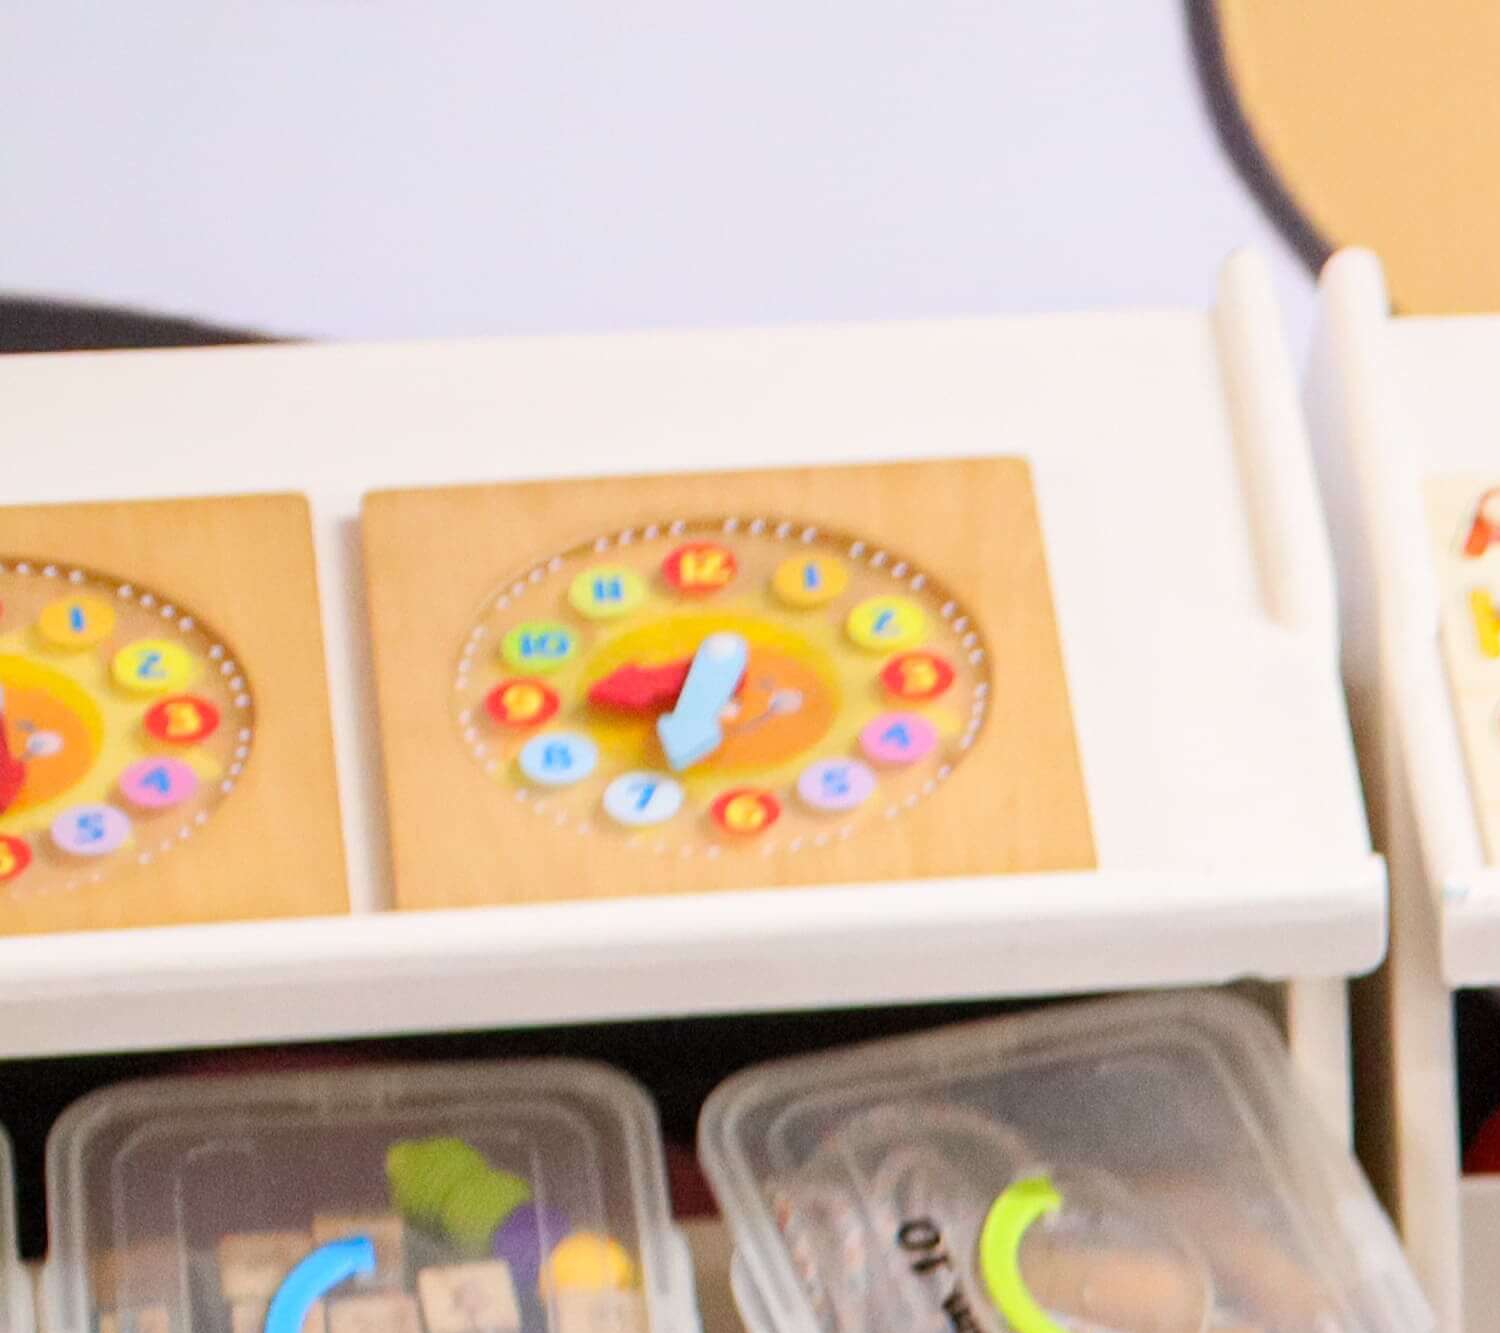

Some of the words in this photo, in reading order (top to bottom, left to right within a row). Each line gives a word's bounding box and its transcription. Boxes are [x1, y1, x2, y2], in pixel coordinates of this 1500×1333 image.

[680, 552, 728, 582] 12
[803, 561, 820, 590] 1
[70, 606, 85, 632] 1
[519, 631, 570, 658] 10
[623, 776, 659, 811] 7
[898, 1218, 950, 1274] 10
